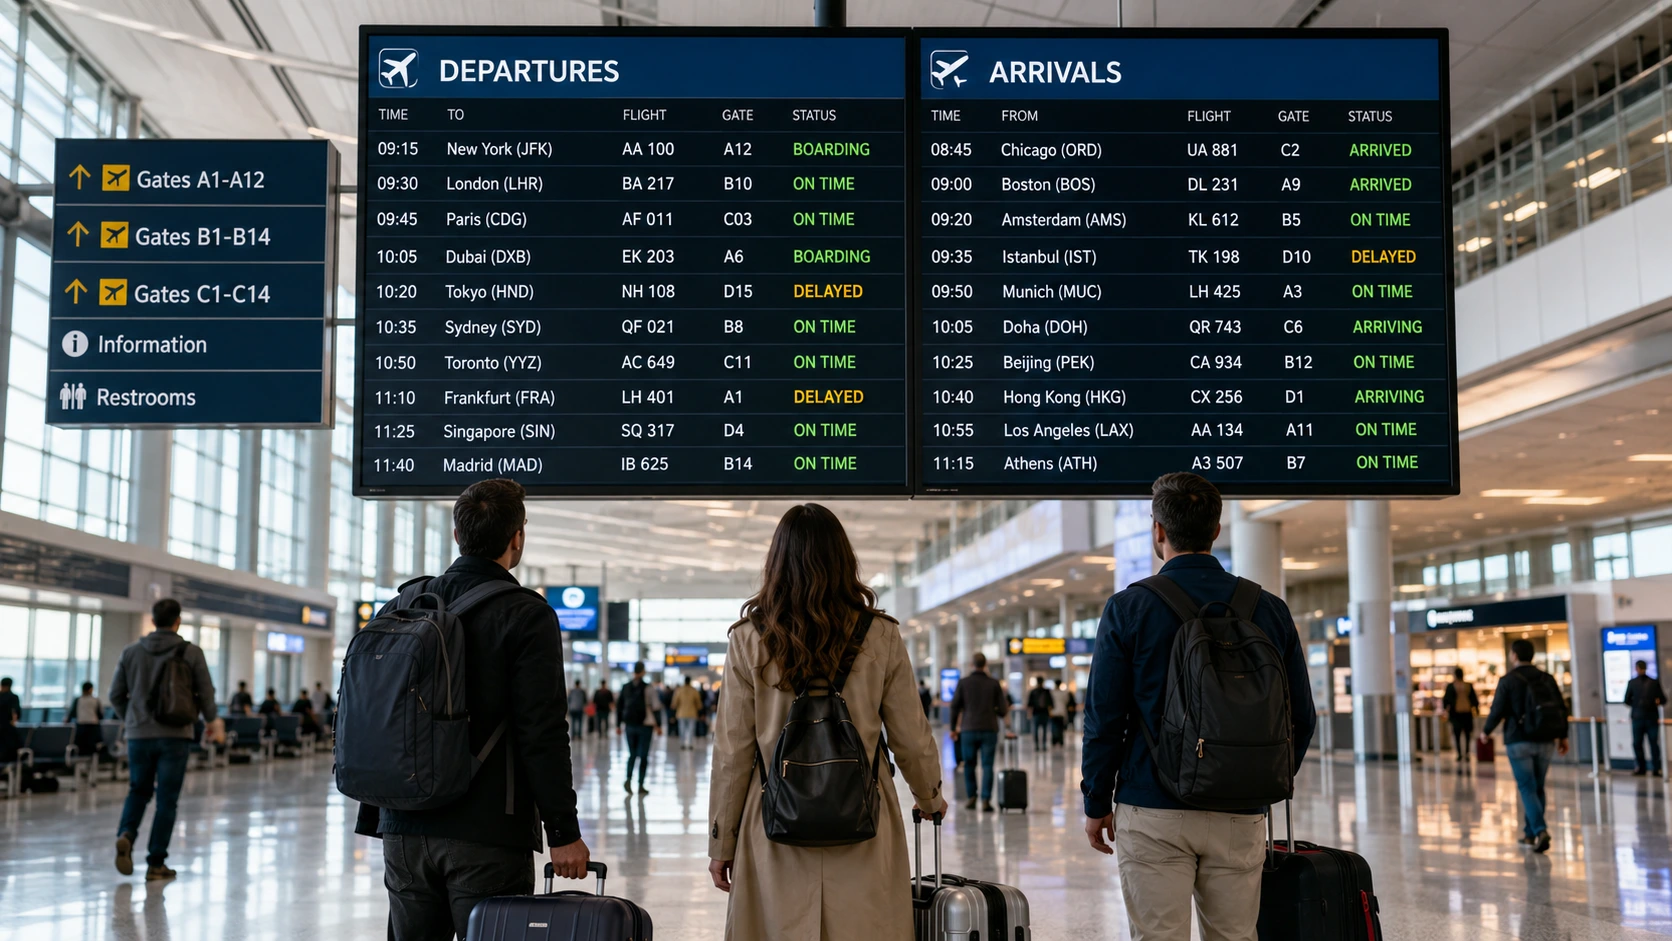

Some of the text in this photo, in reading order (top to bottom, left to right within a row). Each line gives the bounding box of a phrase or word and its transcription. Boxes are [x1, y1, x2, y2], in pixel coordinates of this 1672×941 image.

[441, 60, 619, 82] DEPARTURES
[989, 61, 1121, 83] ARRIVALS
[379, 109, 836, 121] TIME TO FLIGHT GATE STATUS
[932, 110, 1392, 122] TIME FROM FLIGHT GATE STATUS
[378, 142, 869, 157] 09:15 New York (JFK) AA 100 A12 BOARDING
[931, 143, 1411, 160] 08:45 Chicago (ORD) UA 881 C2 ARRIVED
[138, 171, 264, 188] Gates A1-A12
[378, 177, 854, 192] 09:30 London (LHR) BA 217 B10 ON TIME
[932, 177, 1411, 193] 09:00 Boston (BOS) DL 231 A9 ARRIVED
[932, 213, 1410, 228] 09:20 Amsterdam (AMS) KL 612 B5 ON TIME
[136, 228, 270, 245] Gates B1-B14
[378, 250, 870, 266] 10:05 Dubai (DXB) EK 203 A6 BOARDING
[932, 250, 1416, 266] 09:35 Istanbul (IST) TK 198 D10 DELAYED
[135, 285, 270, 303] Gates C1-C14
[377, 284, 862, 301] 10:20 Tokyo (HND) NH 108 D15 DELAYED
[932, 285, 1412, 300] 09:50 Munich (MUC) LH 425 A3 ON TIME
[377, 320, 855, 337] 10:35 Sydney (SYD) QF 021 B8 ON TIME
[933, 320, 1422, 336] 10:05 Doha (DOH) QR 743 C6 ARRIVING
[99, 335, 206, 353] Information
[98, 388, 195, 406] Restrooms
[376, 390, 863, 406] 11:10 Frankfurt (FRA) LH 401 A1 DELAYED
[934, 390, 1424, 407] 10:40 Hong Kong (HKG) CX 256 D1 ARRIVING
[375, 423, 856, 441] 11:25 Singapore (SIN) SQ 317 D4 ON TIME
[934, 423, 1417, 440] 10:55 Los Angeles (LAX) AA 134 A11 ON TIME
[375, 457, 856, 474] 11:40 Madrid (MAD) IB 625 B14 ON TIME
[934, 456, 1418, 472] 11:15 Athens (ATH) A3 507 B7 ON TIME
